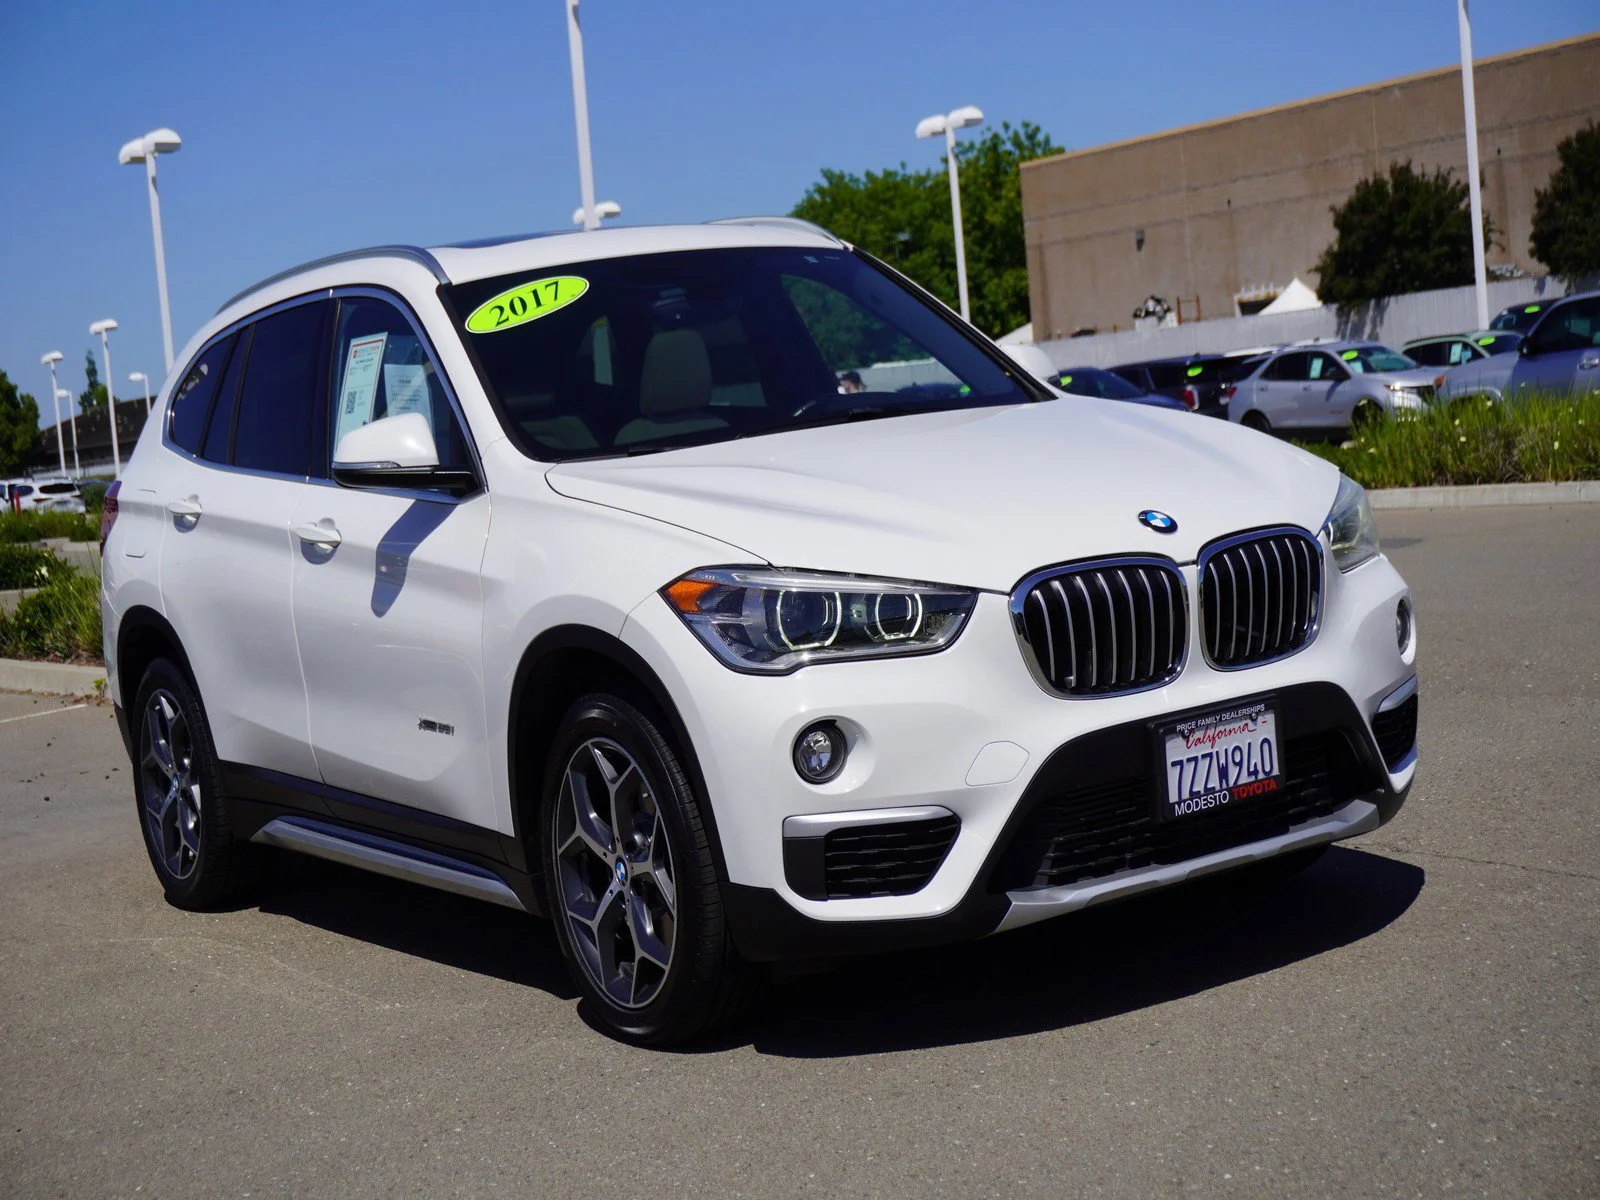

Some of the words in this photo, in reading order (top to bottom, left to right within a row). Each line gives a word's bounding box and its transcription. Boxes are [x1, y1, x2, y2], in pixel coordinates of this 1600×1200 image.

[489, 281, 559, 327] 2017
[1176, 721, 1197, 732] PRICE
[1197, 714, 1221, 728] FAMILY
[1221, 703, 1265, 721] DEALERSHIPS
[1185, 722, 1257, 750] California
[1170, 737, 1273, 801] 7ZZW940
[1174, 790, 1229, 817] MODESTO
[1233, 779, 1277, 800] TOYOTA
